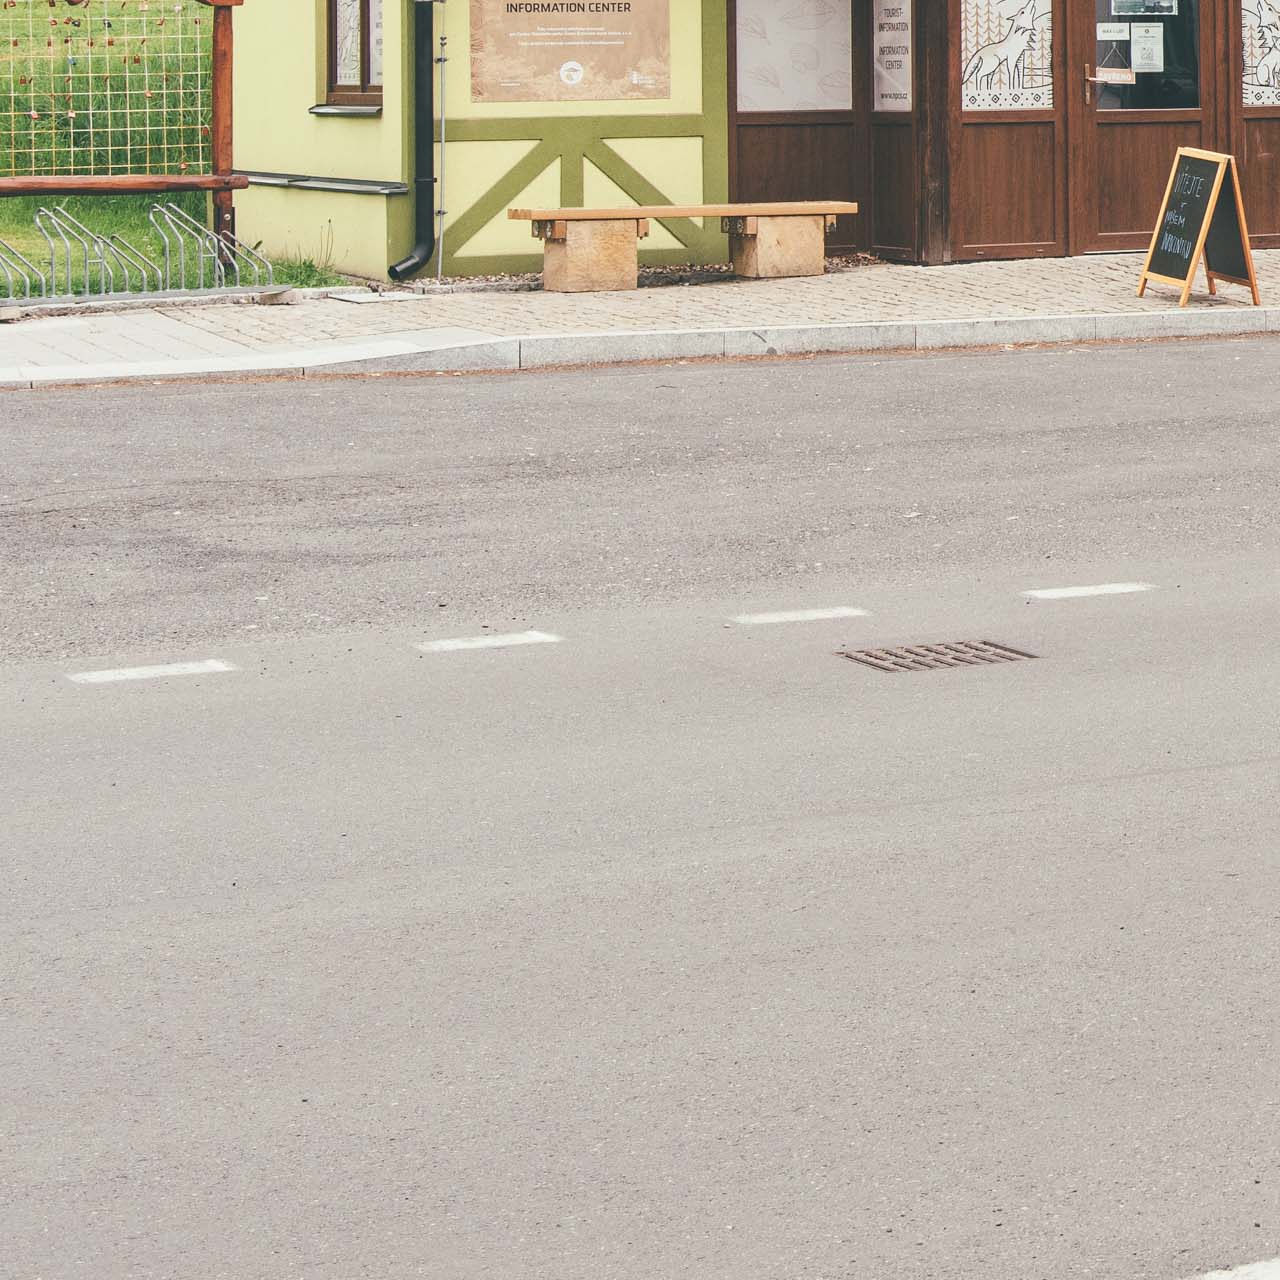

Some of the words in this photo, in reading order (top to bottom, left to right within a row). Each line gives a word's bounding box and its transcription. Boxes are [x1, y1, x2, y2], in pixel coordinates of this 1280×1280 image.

[506, 2, 585, 13] INFORMATION
[588, 2, 632, 13] CENTER
[878, 22, 909, 33] INFORMATION
[879, 45, 909, 56] INFORMATION
[885, 59, 903, 70] CENTER
